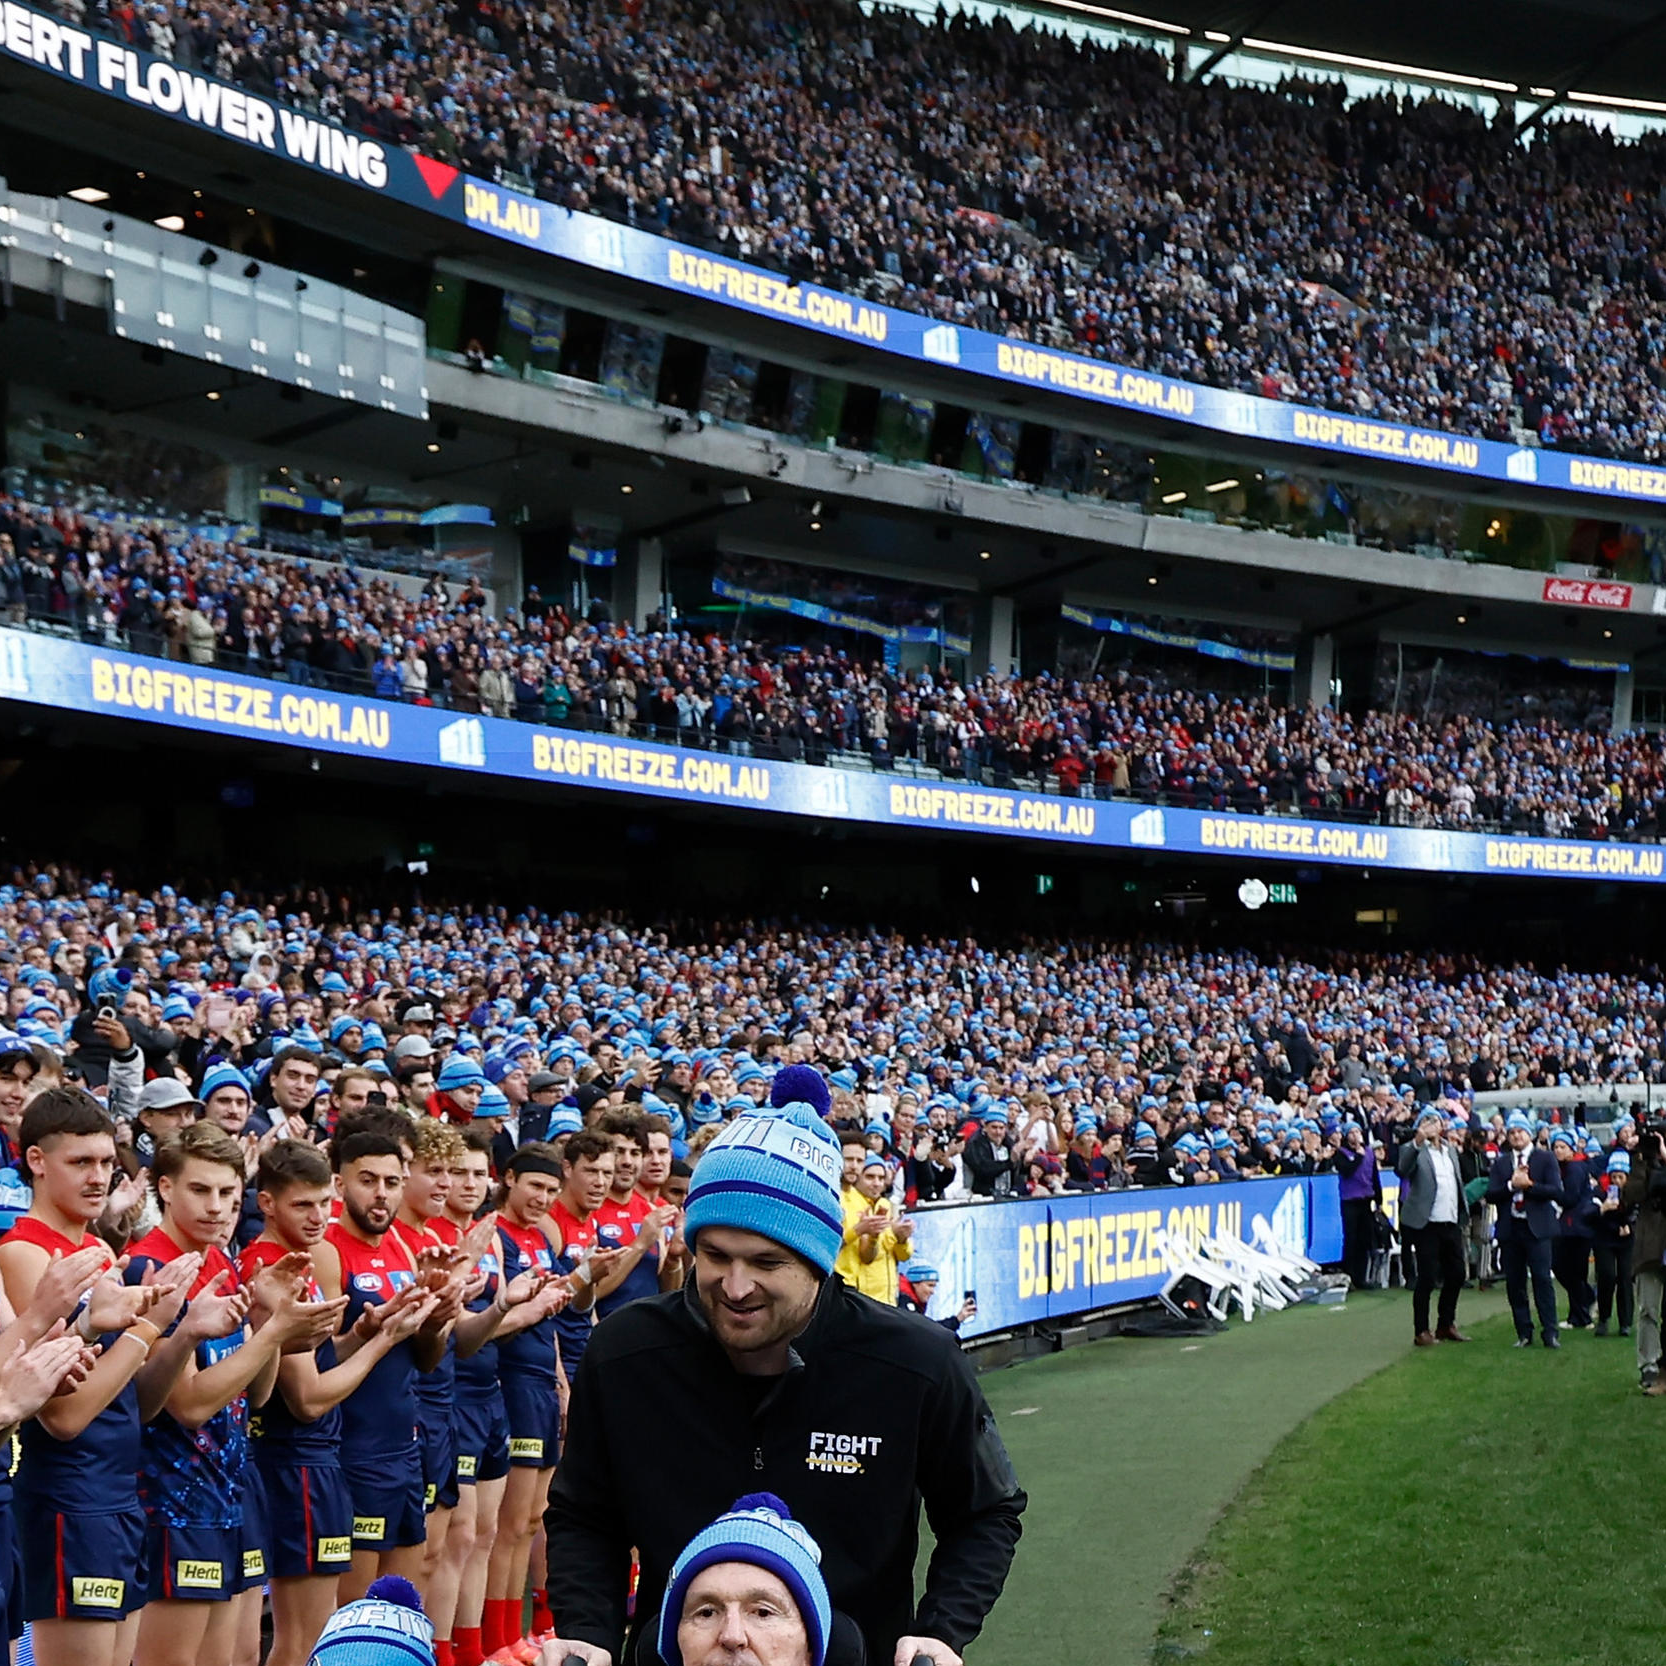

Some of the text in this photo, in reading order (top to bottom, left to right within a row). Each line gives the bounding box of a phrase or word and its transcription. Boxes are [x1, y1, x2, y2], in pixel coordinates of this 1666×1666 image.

[98, 40, 276, 150] FLOWER
[279, 108, 387, 188] WING
[669, 249, 887, 342] BIGFREEZE.COM.AU
[998, 343, 1194, 416] BIGFREEZE.COM.AU
[1294, 411, 1478, 468] BIGFREEZE.COM.AU
[92, 657, 389, 749] BIGFREEZE.COM.AU
[533, 735, 769, 800] BIGFREEZE.COM.AU
[890, 784, 1094, 836] BIGFREEZE.COM.AU
[1201, 817, 1387, 860] BIGFREEZE.COM.AU
[1485, 841, 1663, 877] BIGFREEZE.COM.AU
[1018, 1200, 1242, 1298] BIGFREEZE.COMAU
[810, 1431, 883, 1457] FIGHT
[81, 1580, 119, 1599] Hertz
[184, 1565, 220, 1581] Hertz
